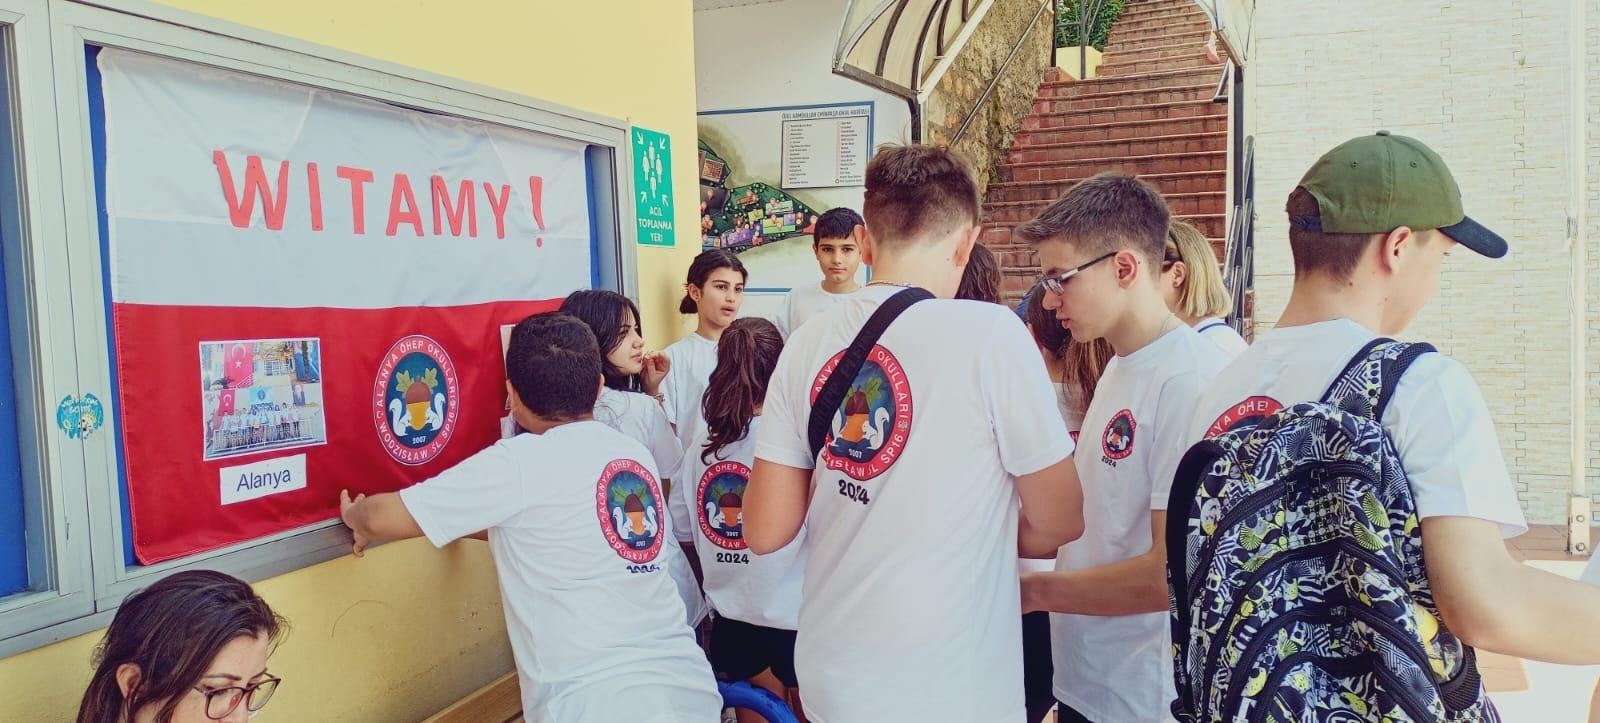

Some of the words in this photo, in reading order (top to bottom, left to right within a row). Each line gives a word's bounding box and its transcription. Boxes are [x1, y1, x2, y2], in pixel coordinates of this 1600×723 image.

[638, 217, 673, 231] TOPLANMA
[376, 353, 398, 407] ALANYA
[815, 359, 840, 393] ANYA
[877, 350, 909, 419] OKULLARI
[379, 423, 429, 461] WODZISŁAW
[880, 433, 904, 465] SP16
[236, 468, 291, 492] Alanya
[716, 551, 750, 565] 2024
